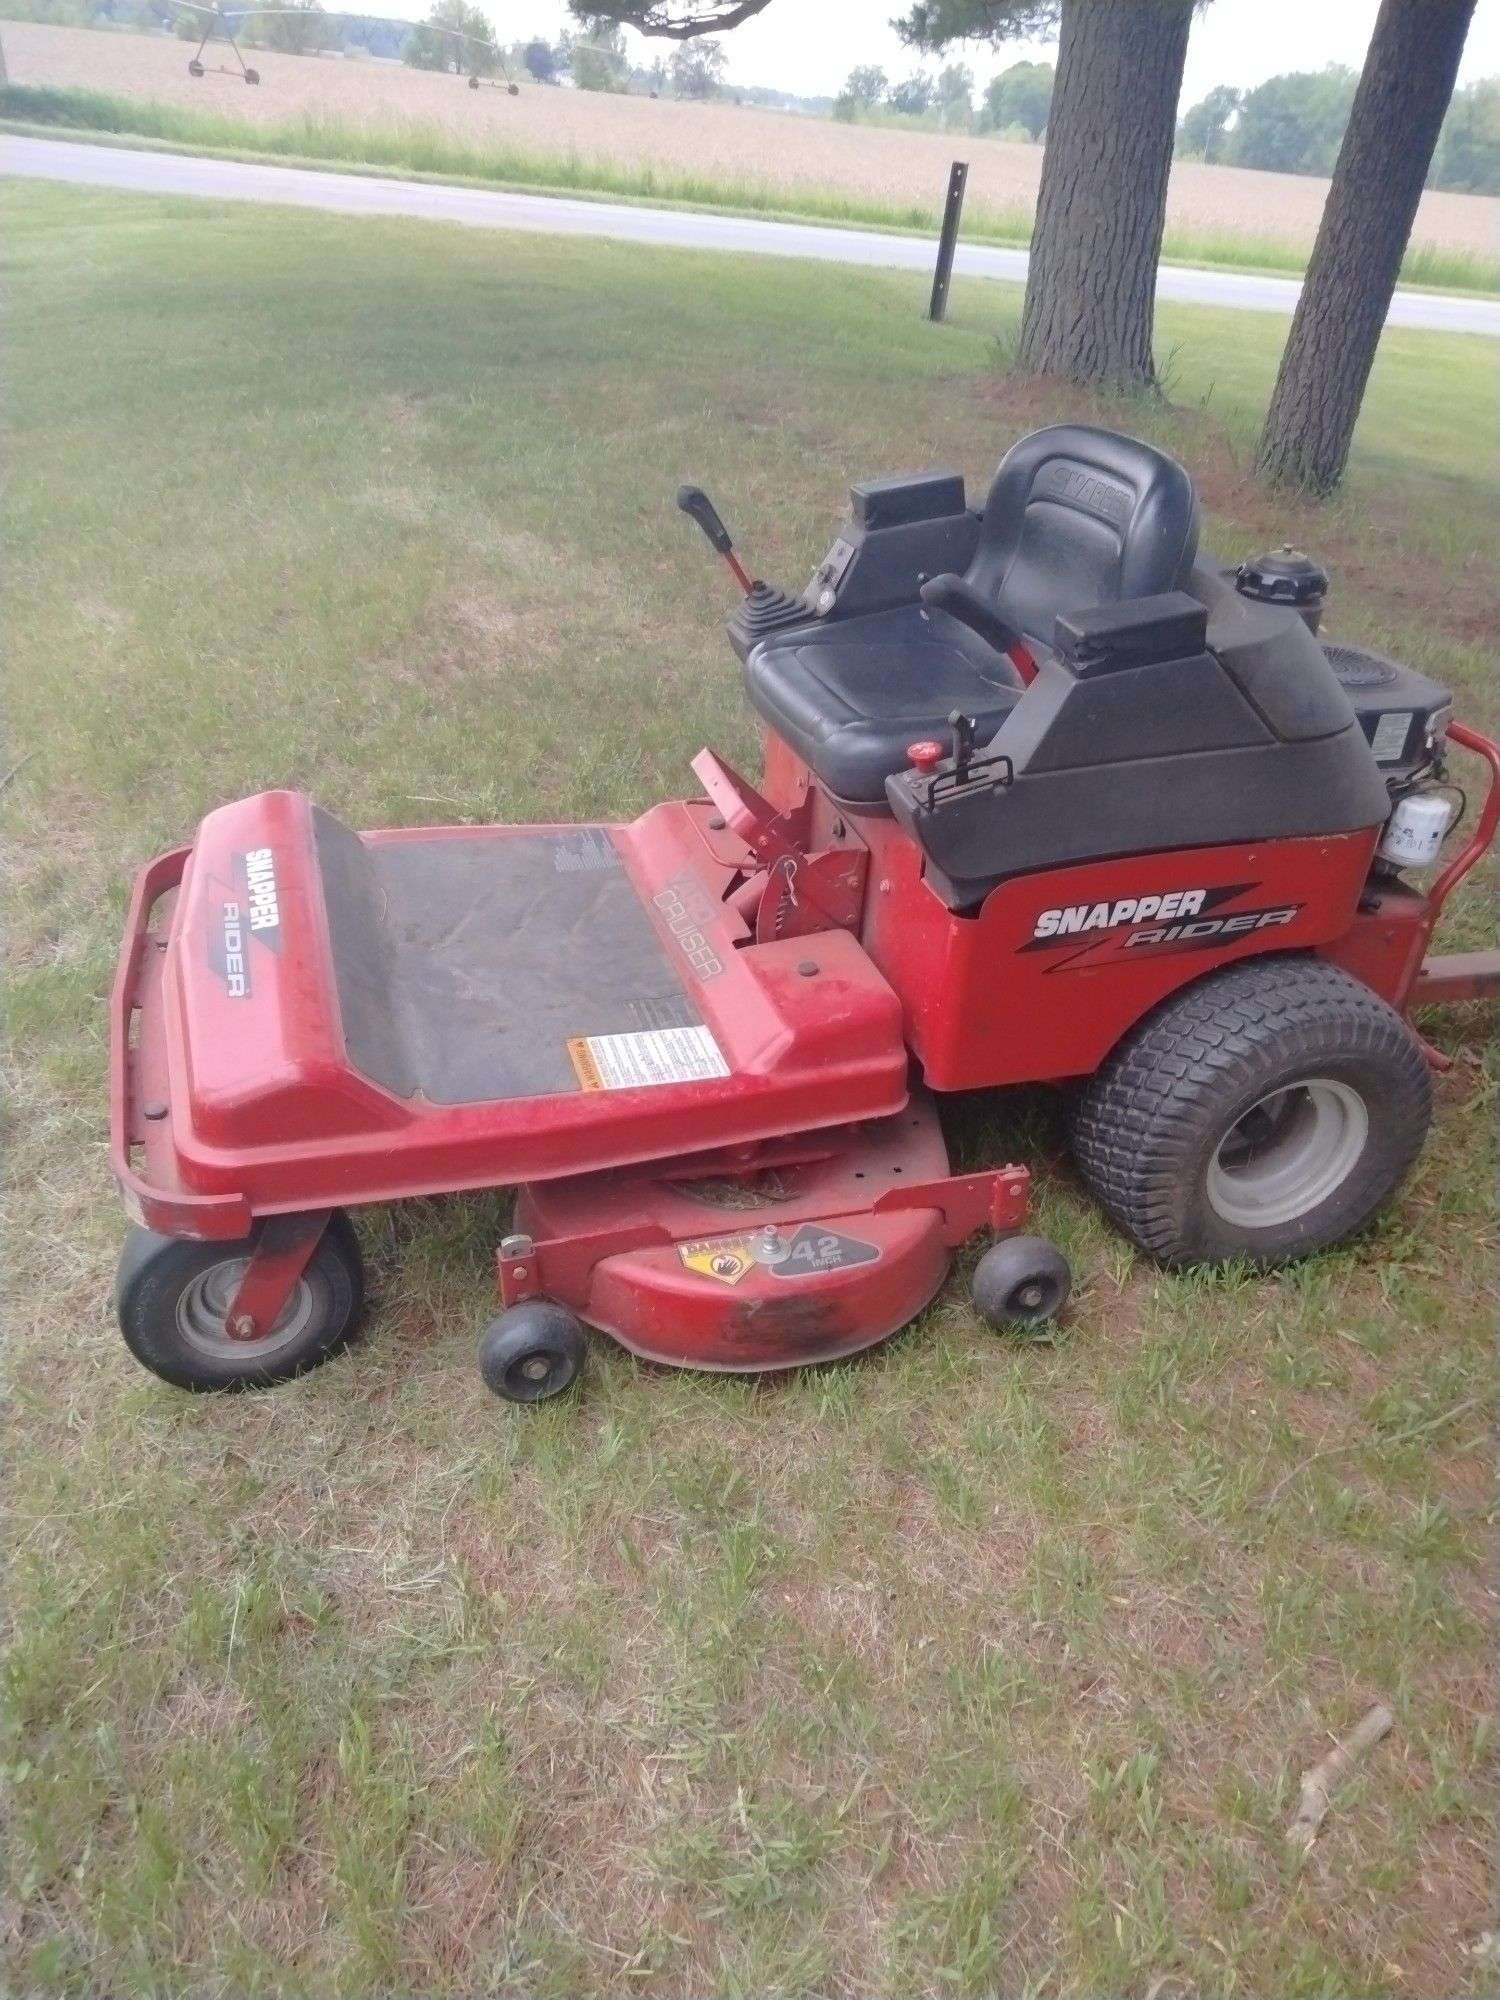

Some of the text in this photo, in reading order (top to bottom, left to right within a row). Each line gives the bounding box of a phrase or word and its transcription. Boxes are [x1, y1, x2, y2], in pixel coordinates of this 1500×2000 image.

[245, 848, 280, 931] SNAPPER
[1033, 889, 1207, 938] SNAPPER
[224, 902, 245, 997] RIDER
[652, 889, 723, 982] CRUISER
[1124, 908, 1298, 948] RIDER
[791, 1236, 842, 1261] 42
